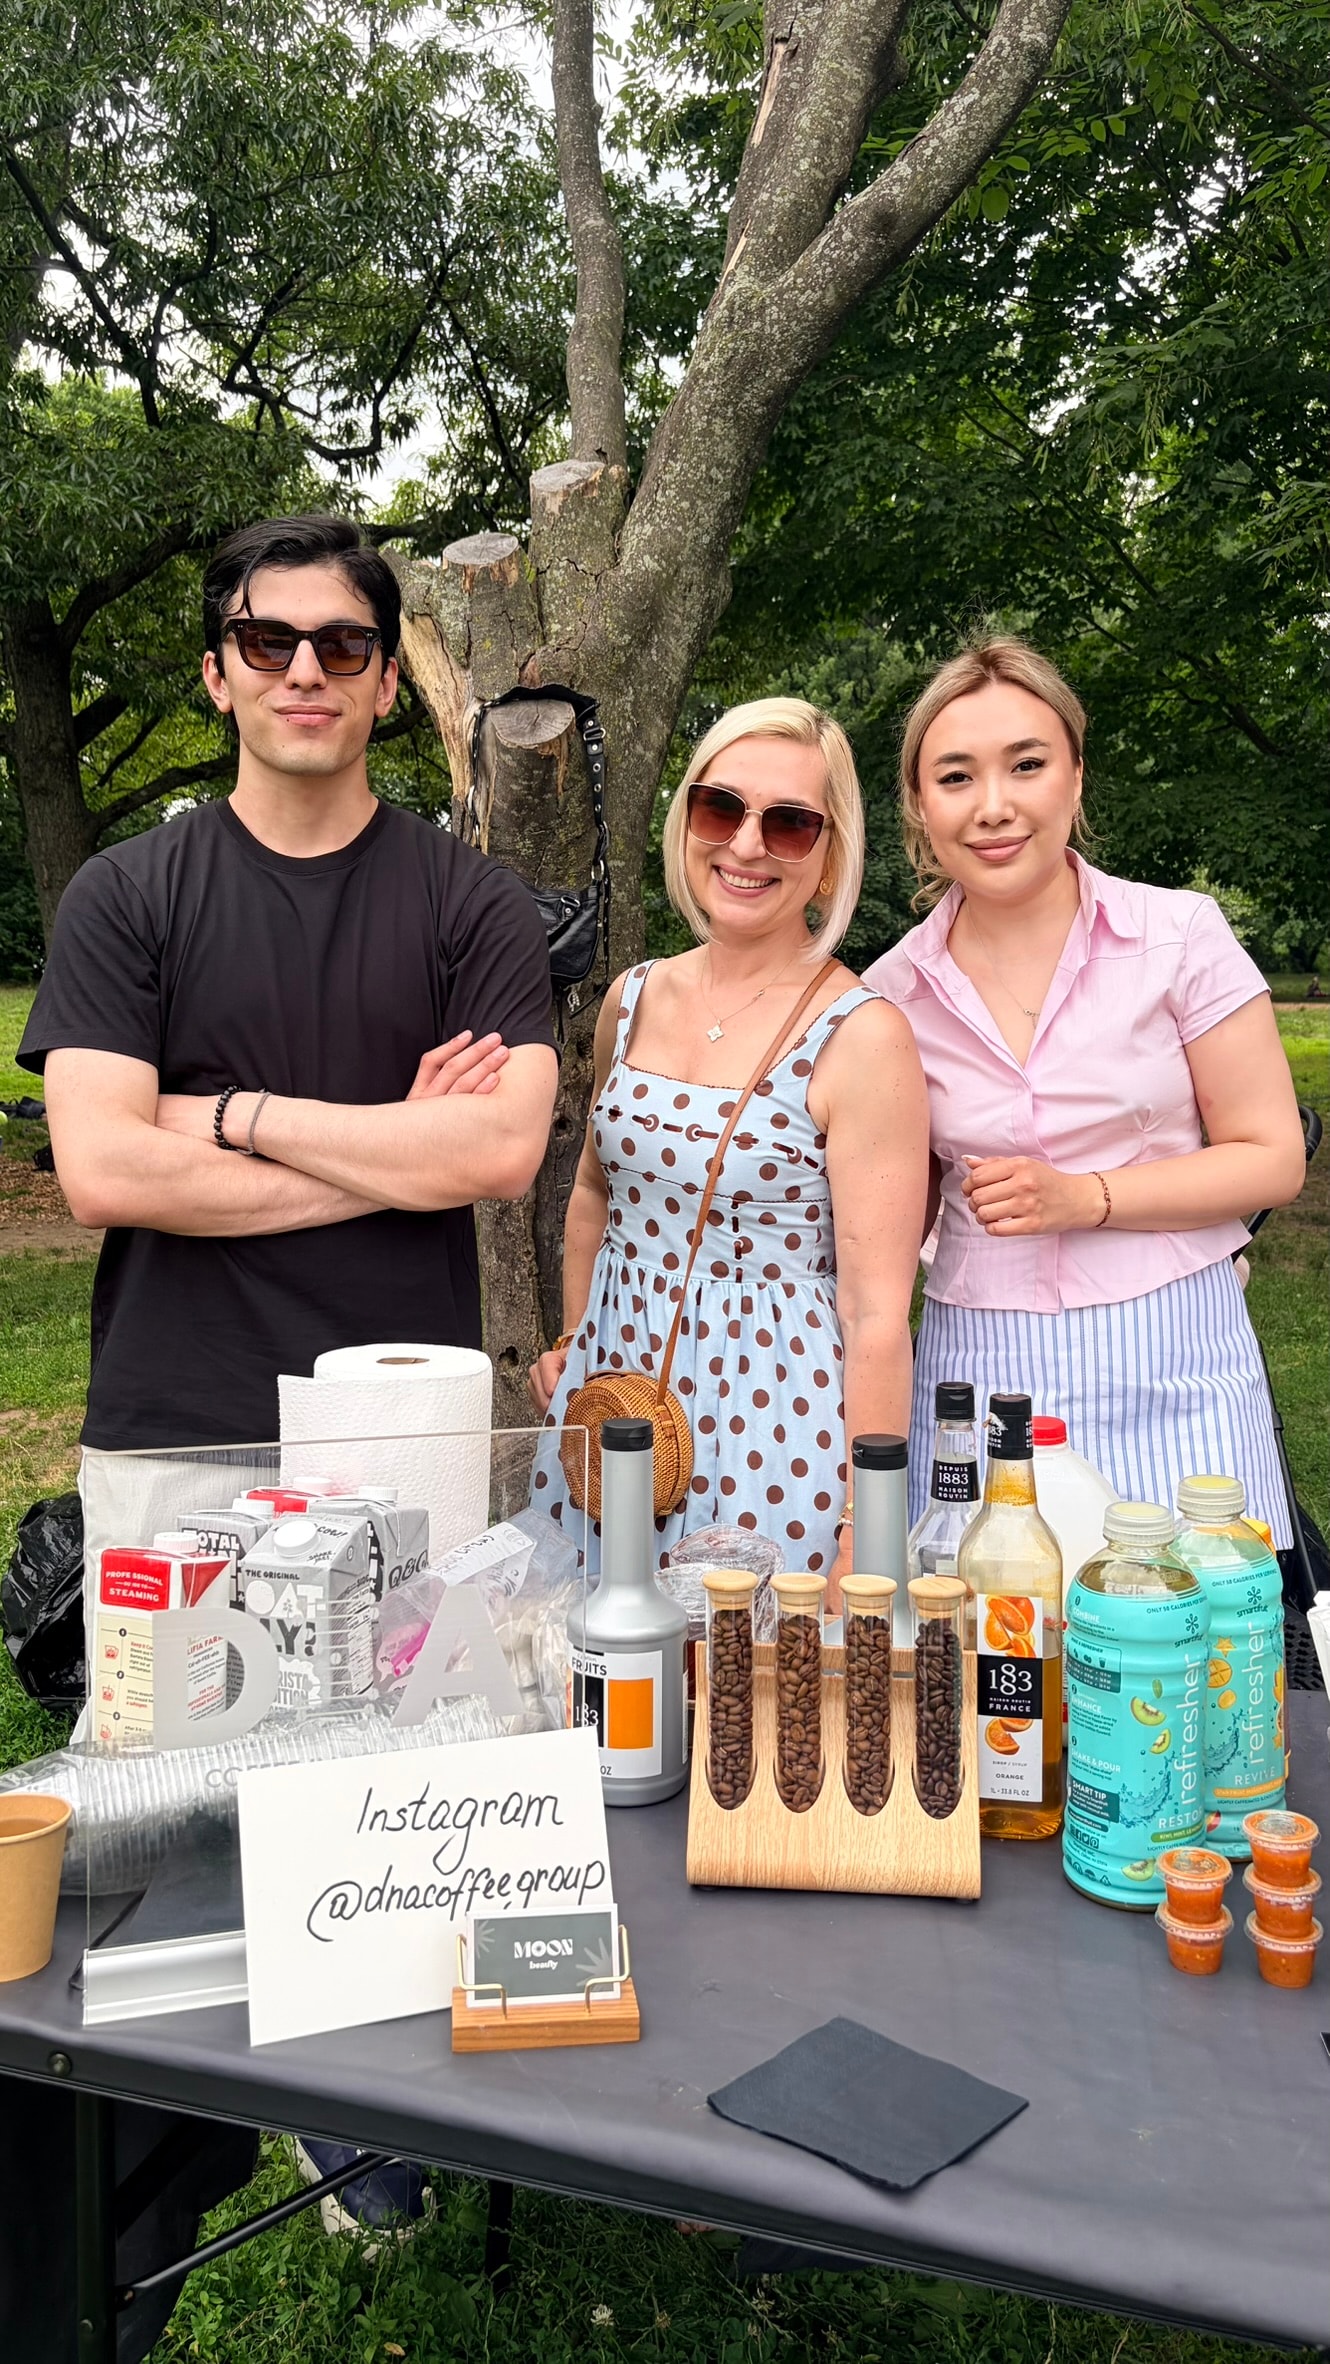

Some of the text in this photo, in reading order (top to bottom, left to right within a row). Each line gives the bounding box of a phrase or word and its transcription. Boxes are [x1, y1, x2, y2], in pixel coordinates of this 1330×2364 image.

[938, 1472, 969, 1485] 1883
[182, 1528, 240, 1551] OTAL
[262, 1571, 300, 1580] ORIGINAL
[108, 1588, 160, 1602] STEAMING
[1146, 1606, 1162, 1614] ONLY
[1241, 1621, 1265, 1765] refresher
[989, 1703, 1031, 1713] FRANCE
[1174, 1653, 1200, 1805] refresher
[1098, 1760, 1121, 1772] POUR
[1234, 1766, 1277, 1786] REVIVE
[1072, 1780, 1107, 1800] SMART TIP
[357, 1781, 564, 1876] Instagram
[514, 1938, 574, 1959] MOON
[529, 1960, 558, 1970] beauty
